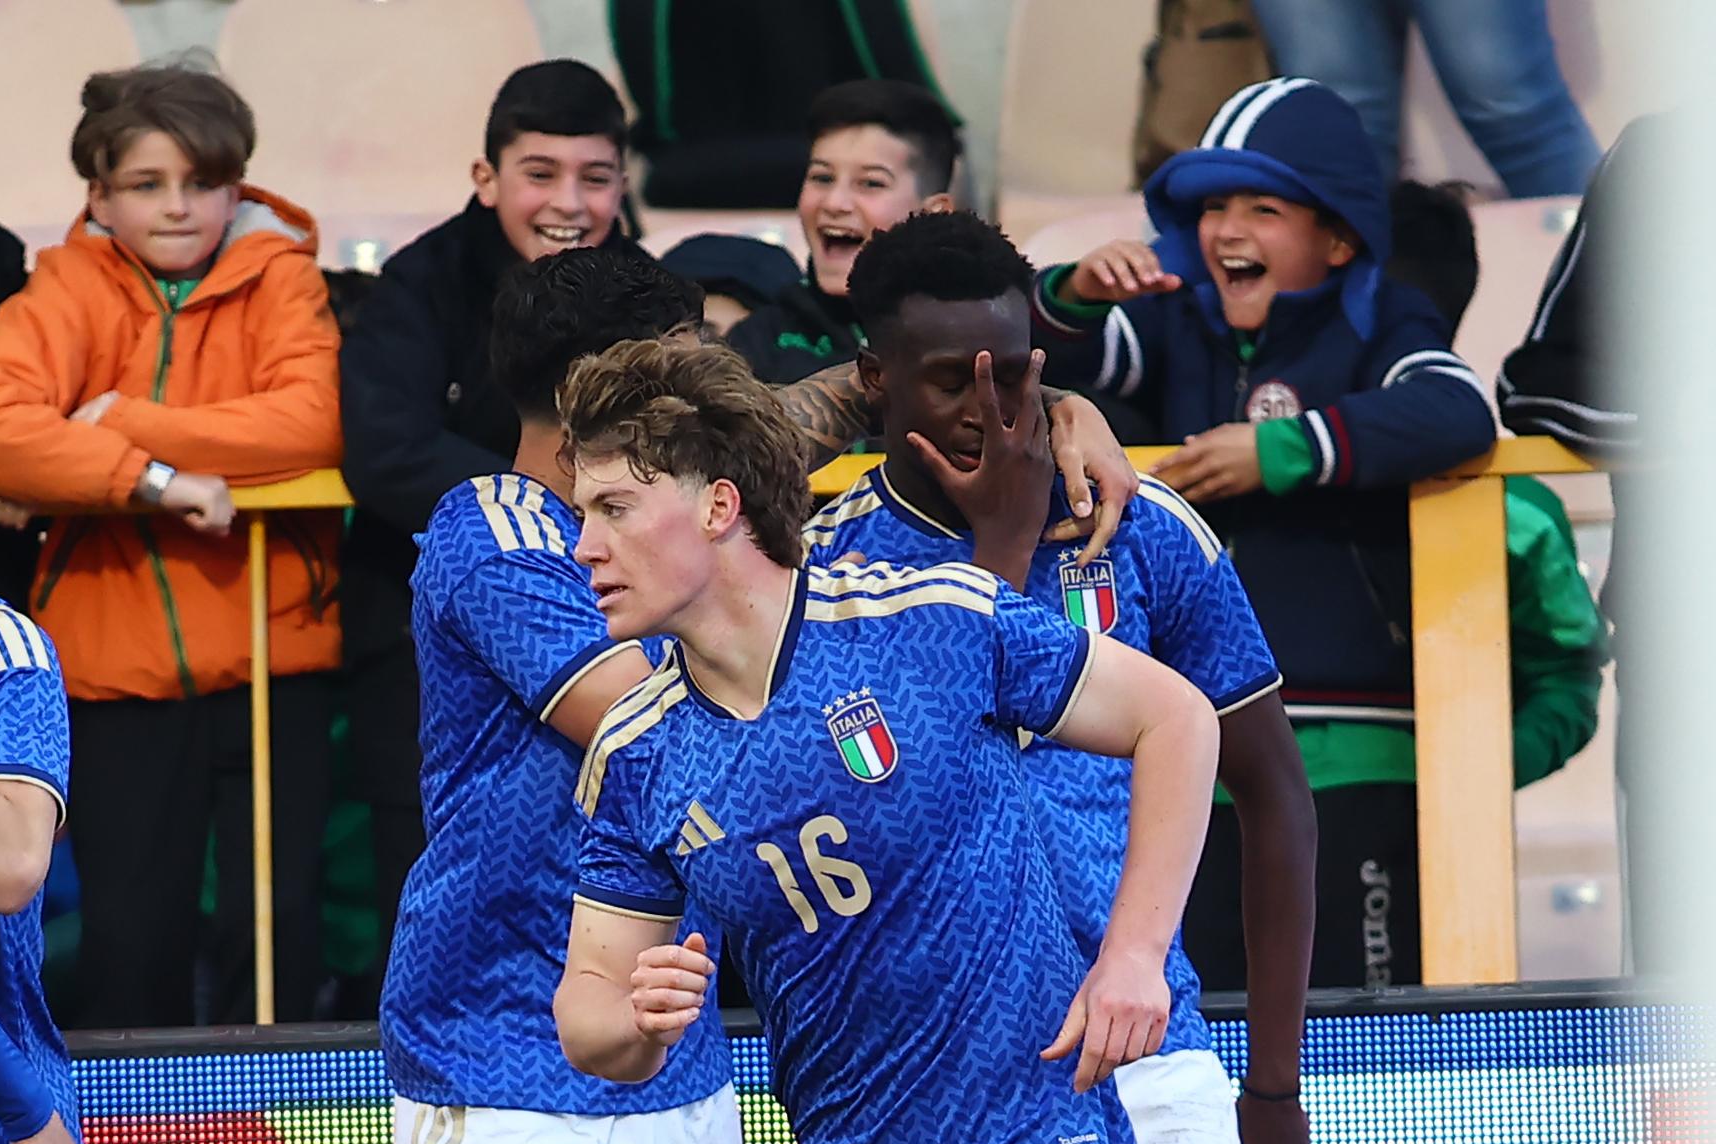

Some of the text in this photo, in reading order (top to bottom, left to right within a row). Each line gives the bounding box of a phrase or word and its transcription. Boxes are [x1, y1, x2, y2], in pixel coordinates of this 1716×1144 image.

[1064, 566, 1110, 584] ITALIA
[832, 706, 877, 736] ITALIA
[756, 814, 872, 933] 16
